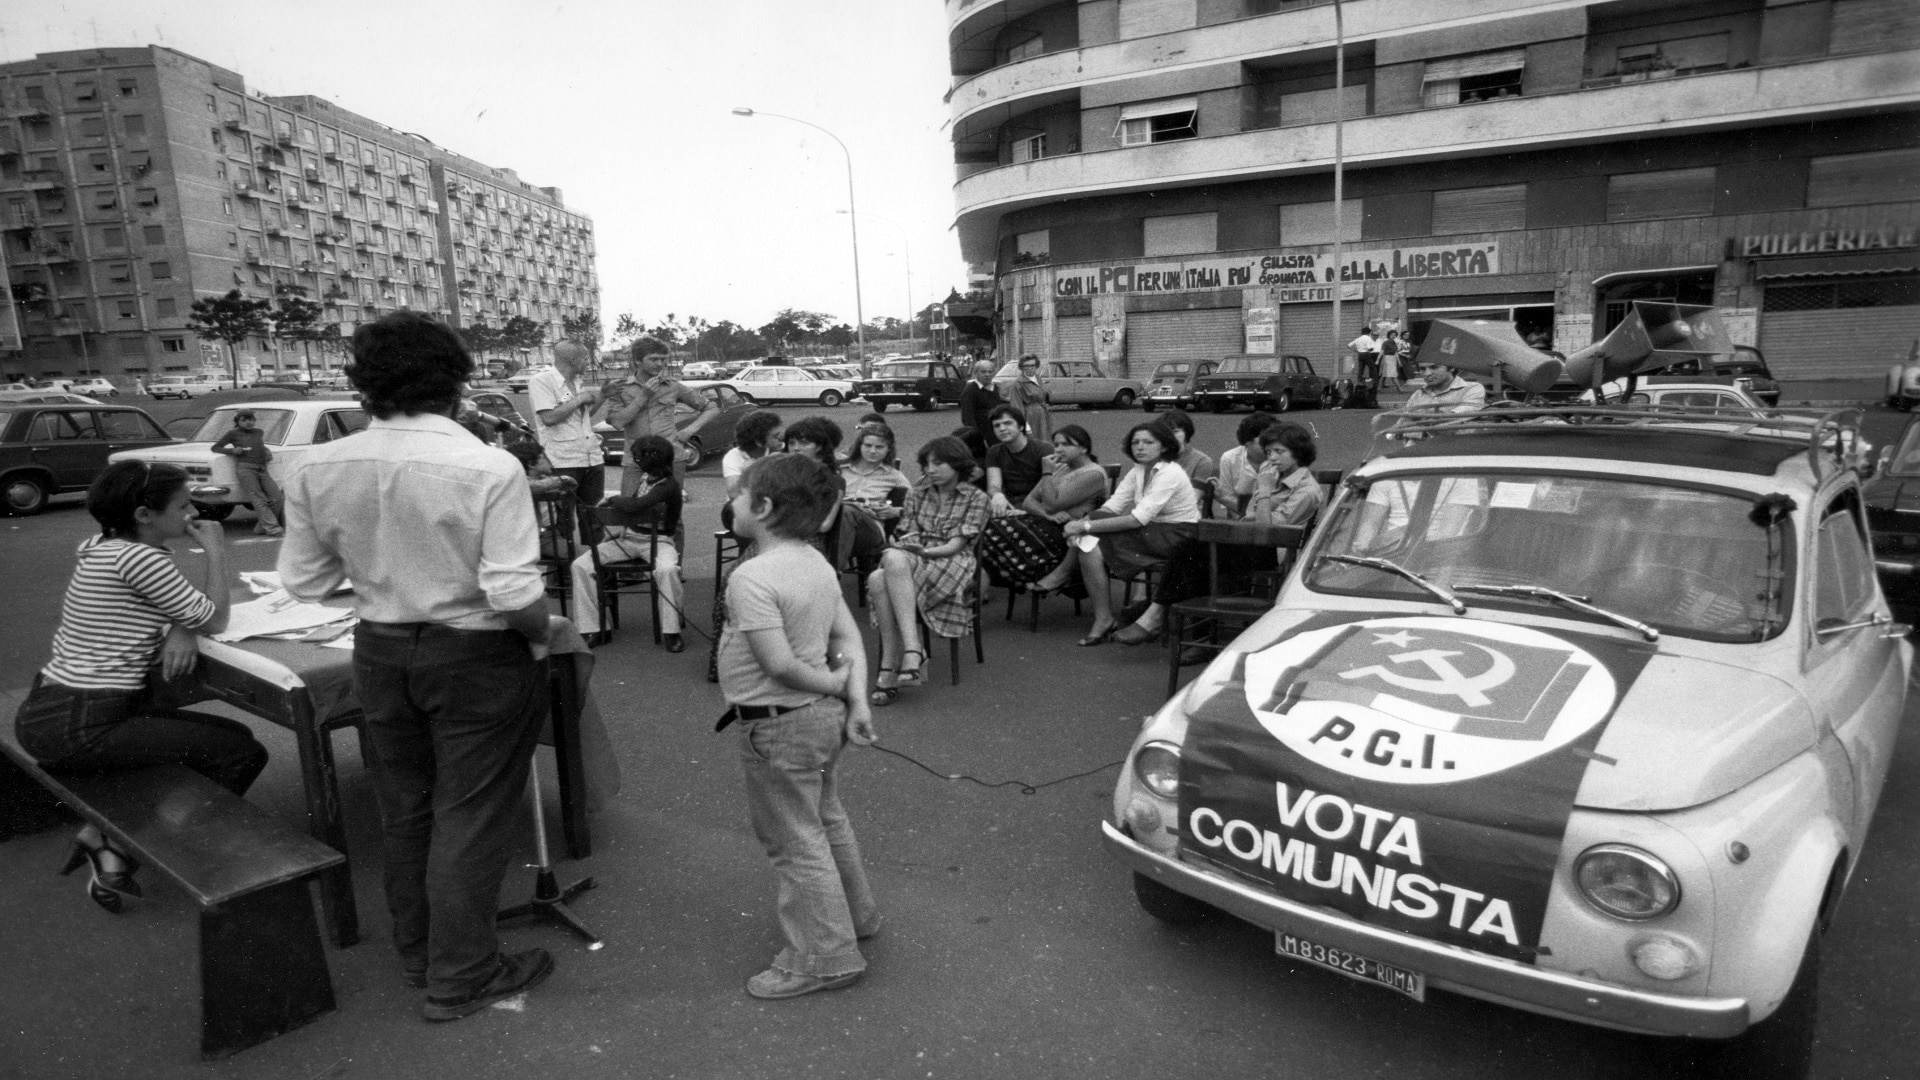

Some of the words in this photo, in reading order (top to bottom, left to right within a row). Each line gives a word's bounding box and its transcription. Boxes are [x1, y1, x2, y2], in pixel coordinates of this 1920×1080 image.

[1259, 270, 1317, 285] ORDINATA
[1261, 255, 1314, 269] GIUSTA
[1325, 260, 1389, 283] NELLA
[1391, 246, 1495, 278] LIBERTA'
[1057, 277, 1082, 296] CON
[1086, 276, 1098, 294] IL
[1099, 266, 1135, 294] PCI
[1137, 271, 1161, 291] PER
[1185, 267, 1221, 288] ITALIA
[1280, 289, 1307, 301] CINE
[1309, 288, 1333, 300] FOT
[1308, 715, 1456, 770] P.C.I.
[1275, 781, 1424, 866] VOTA
[1190, 807, 1520, 945] COMUNISTA
[1285, 935, 1366, 975] M83623
[1376, 963, 1417, 993] ROMA
